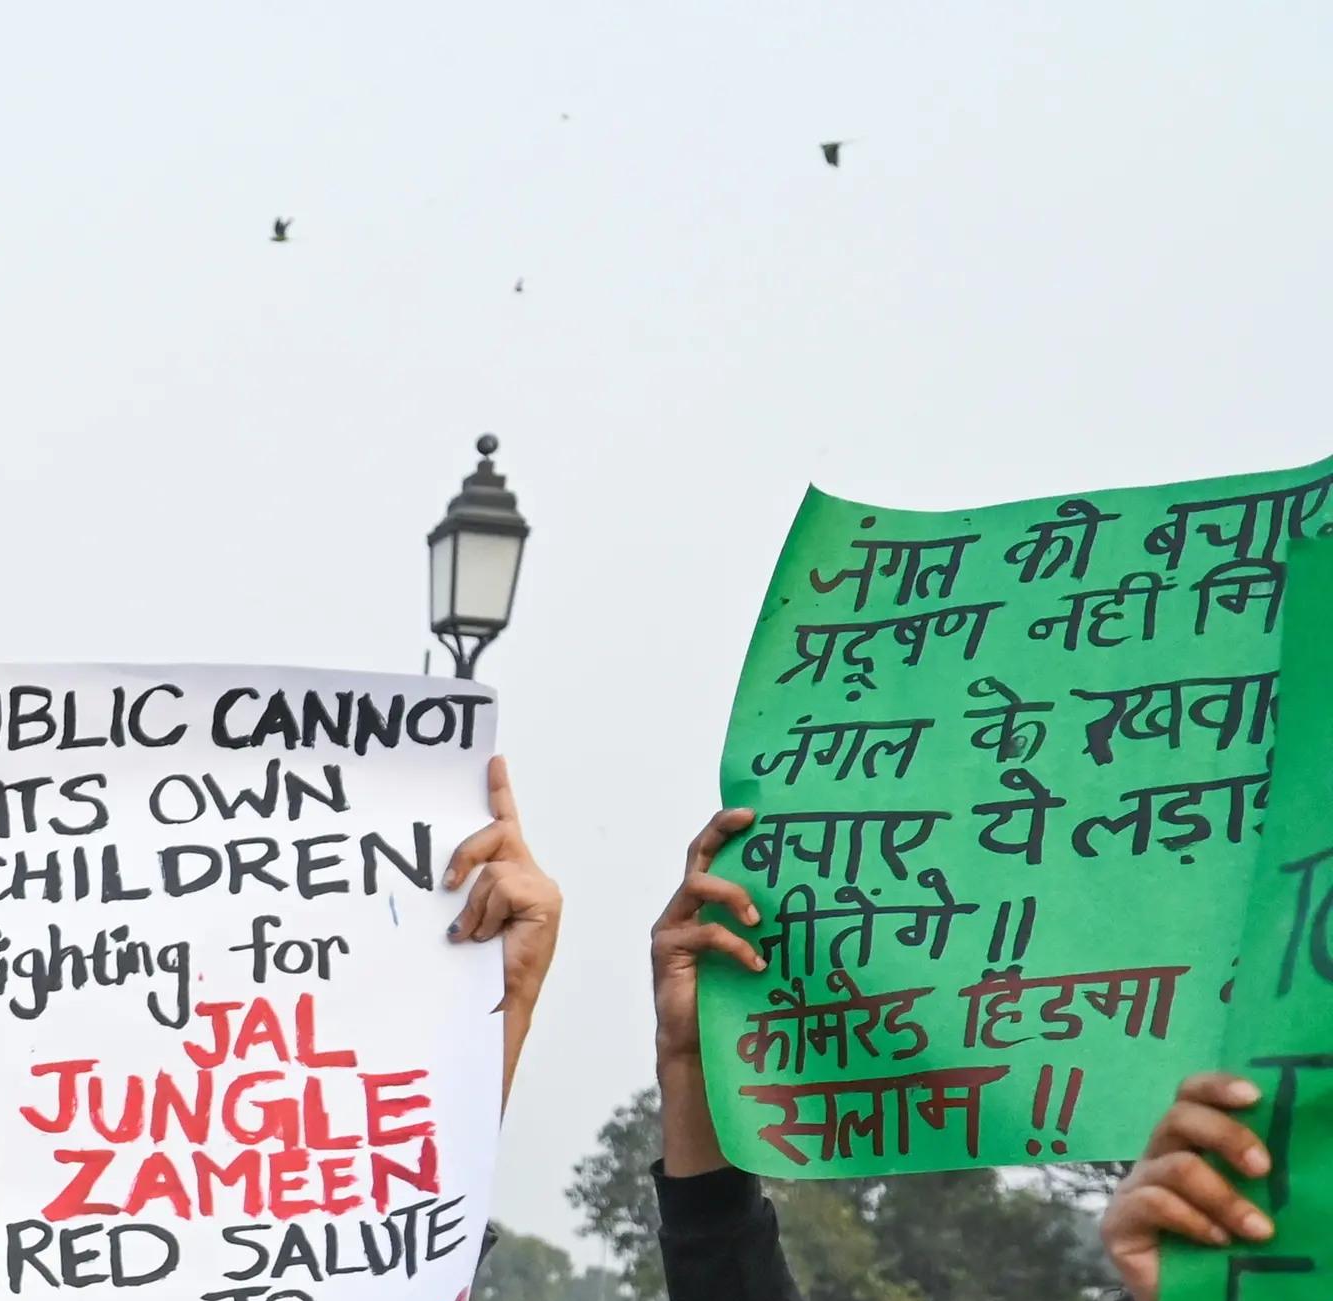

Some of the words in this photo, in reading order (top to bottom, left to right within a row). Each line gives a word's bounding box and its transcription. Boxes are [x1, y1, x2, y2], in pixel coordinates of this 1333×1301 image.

[211, 687, 494, 756] CANNOT
[964, 676, 1055, 764] के
[1070, 670, 1279, 766] रखवा
[149, 758, 350, 826] OWN
[230, 915, 350, 983] for
[182, 993, 357, 1069] JAL
[20, 1059, 435, 1150] JUNGLE
[739, 1065, 1010, 1166] सलाम
[42, 1136, 441, 1221] ZAMEEN
[6, 1220, 180, 1293] RED
[222, 1195, 468, 1282] SALUTE
